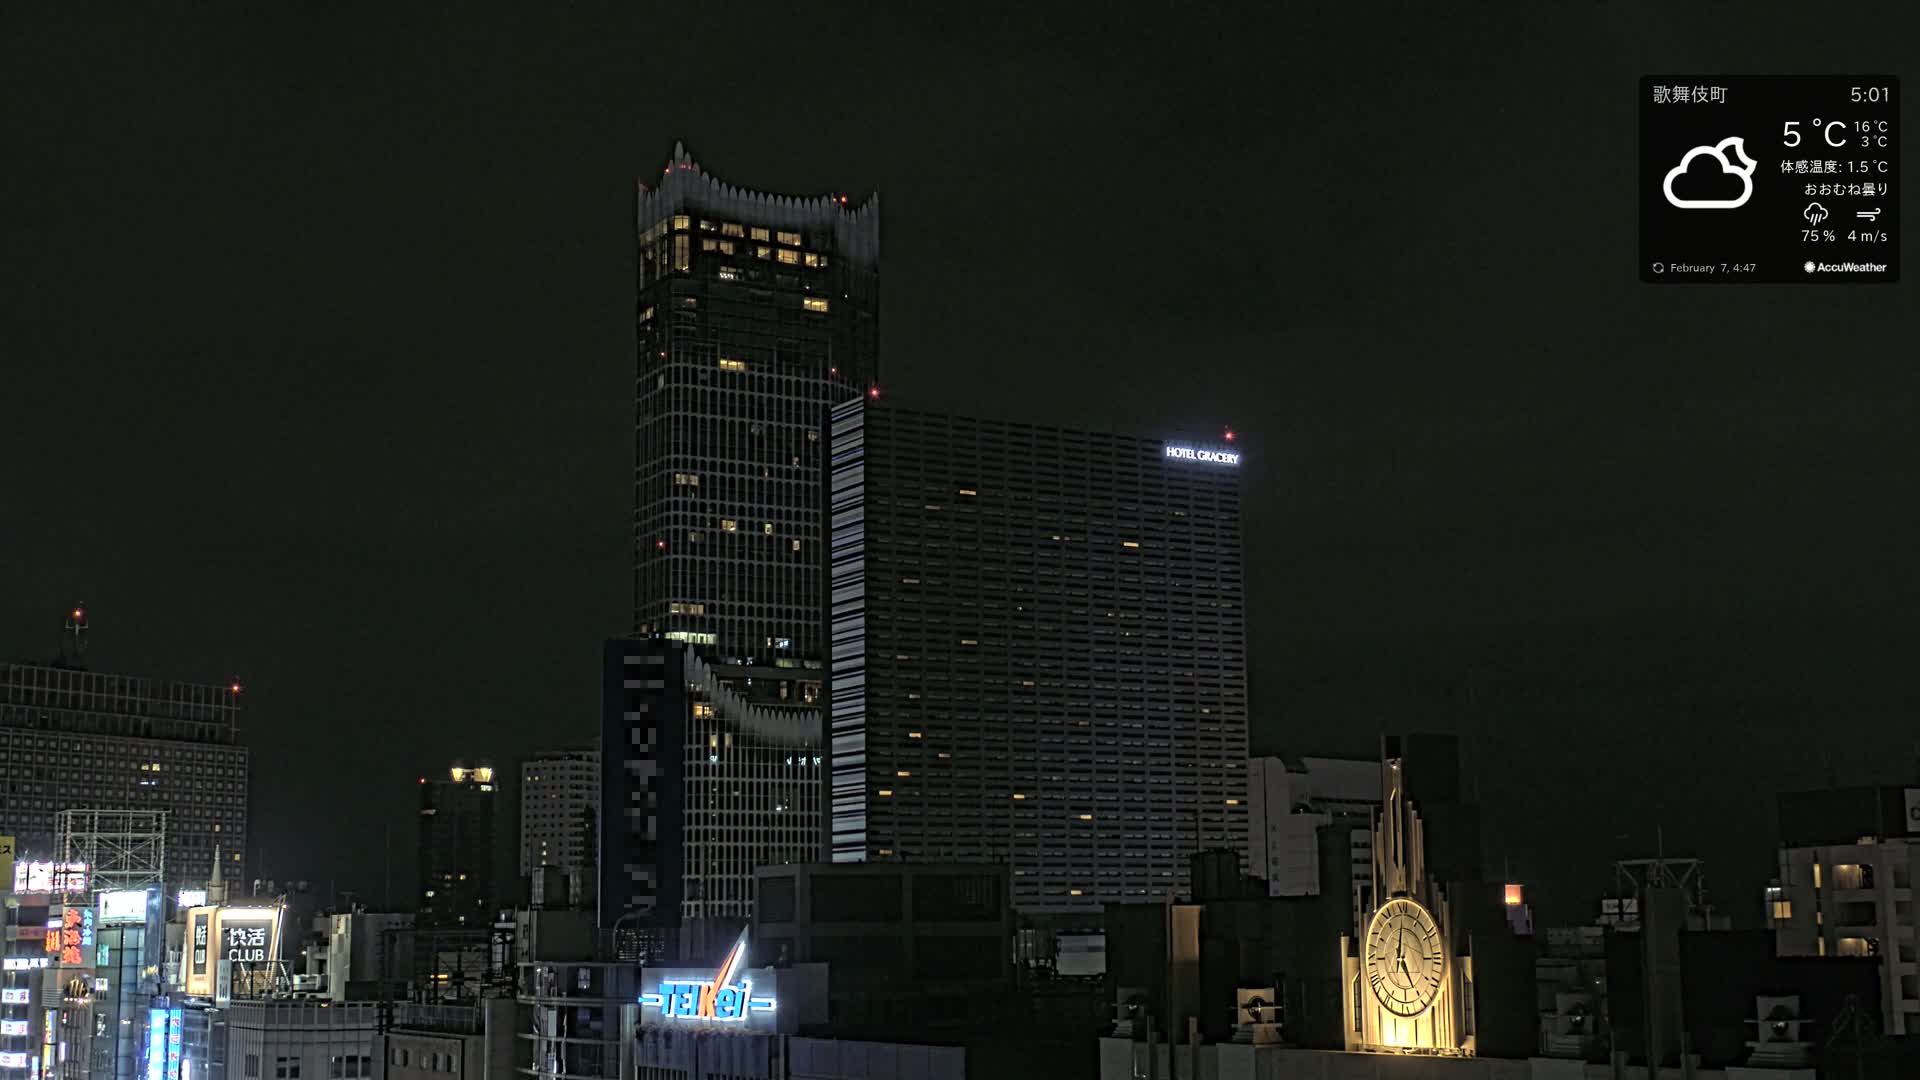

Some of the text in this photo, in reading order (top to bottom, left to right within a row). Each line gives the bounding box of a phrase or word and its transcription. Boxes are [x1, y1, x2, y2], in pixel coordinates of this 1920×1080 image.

[1166, 446, 1240, 464] HOTEL GRACERY
[229, 928, 265, 946] 快活
[228, 949, 265, 962] CLUB
